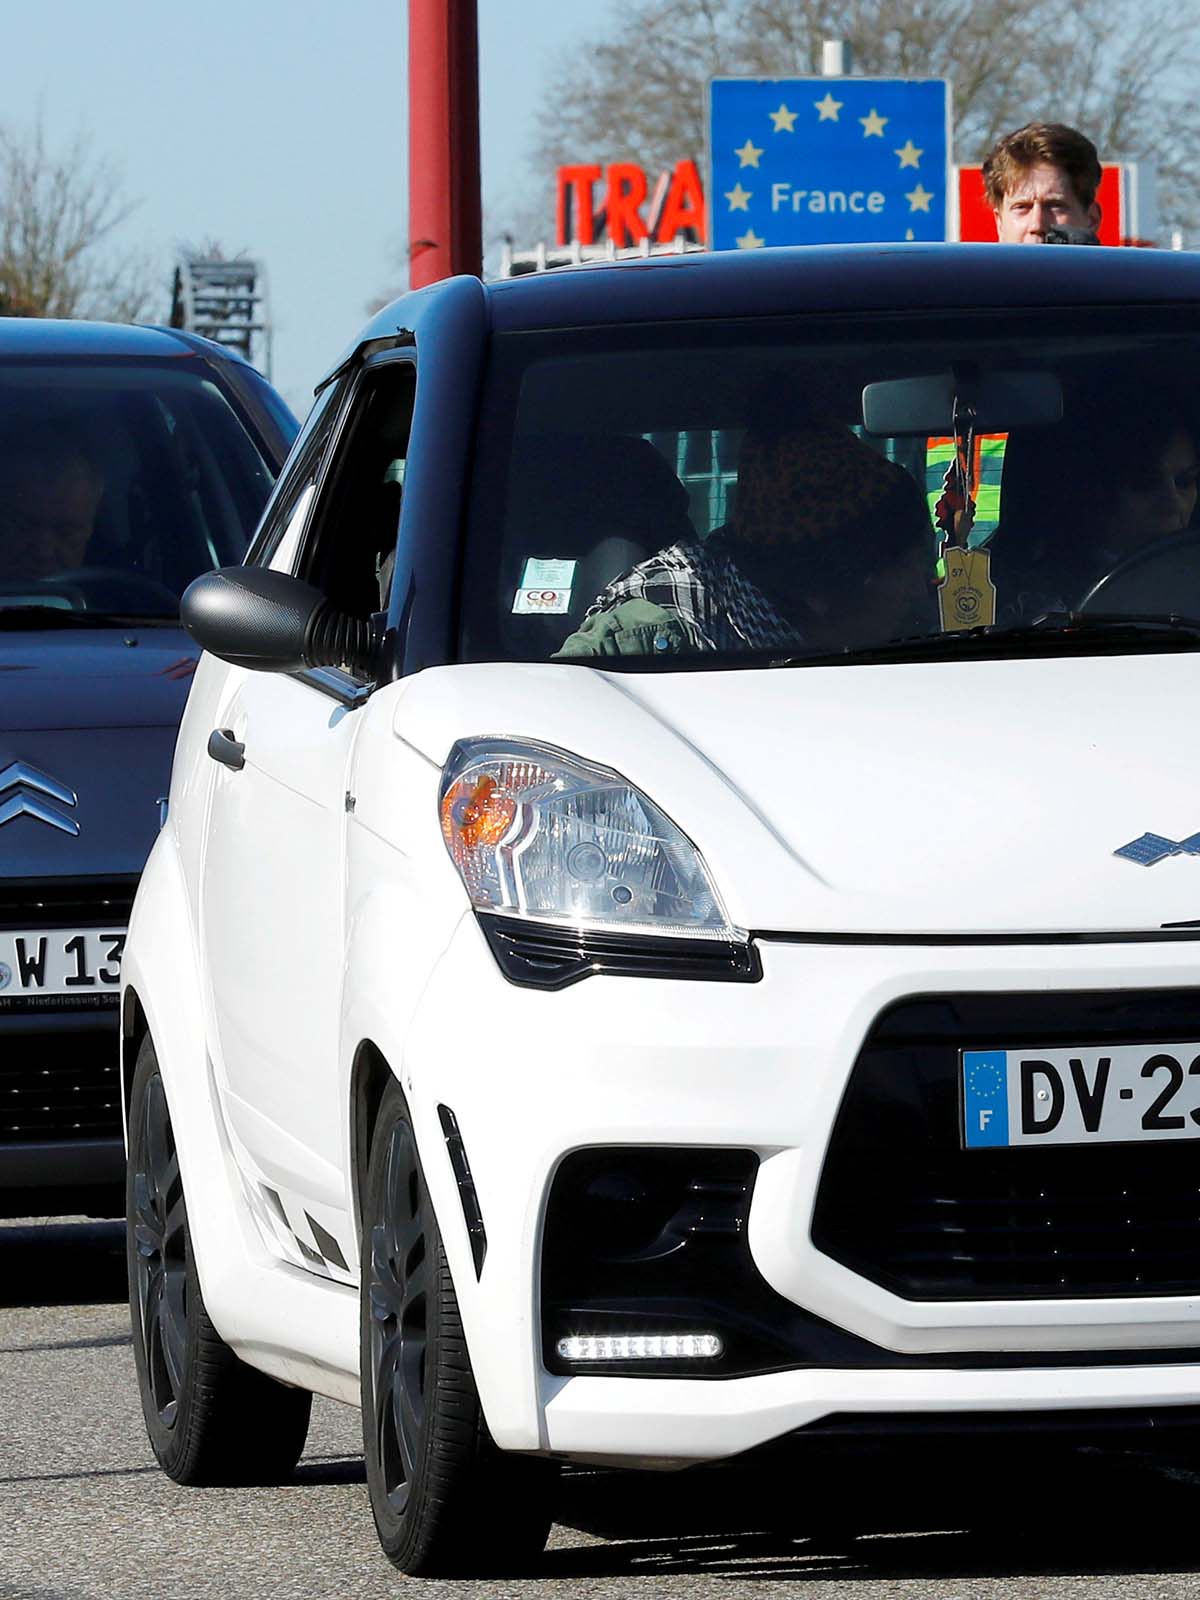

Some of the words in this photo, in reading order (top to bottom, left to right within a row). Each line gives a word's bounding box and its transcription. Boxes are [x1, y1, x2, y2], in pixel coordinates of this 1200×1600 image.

[772, 184, 886, 212] France
[15, 936, 48, 988] W
[979, 1109, 993, 1132] F
